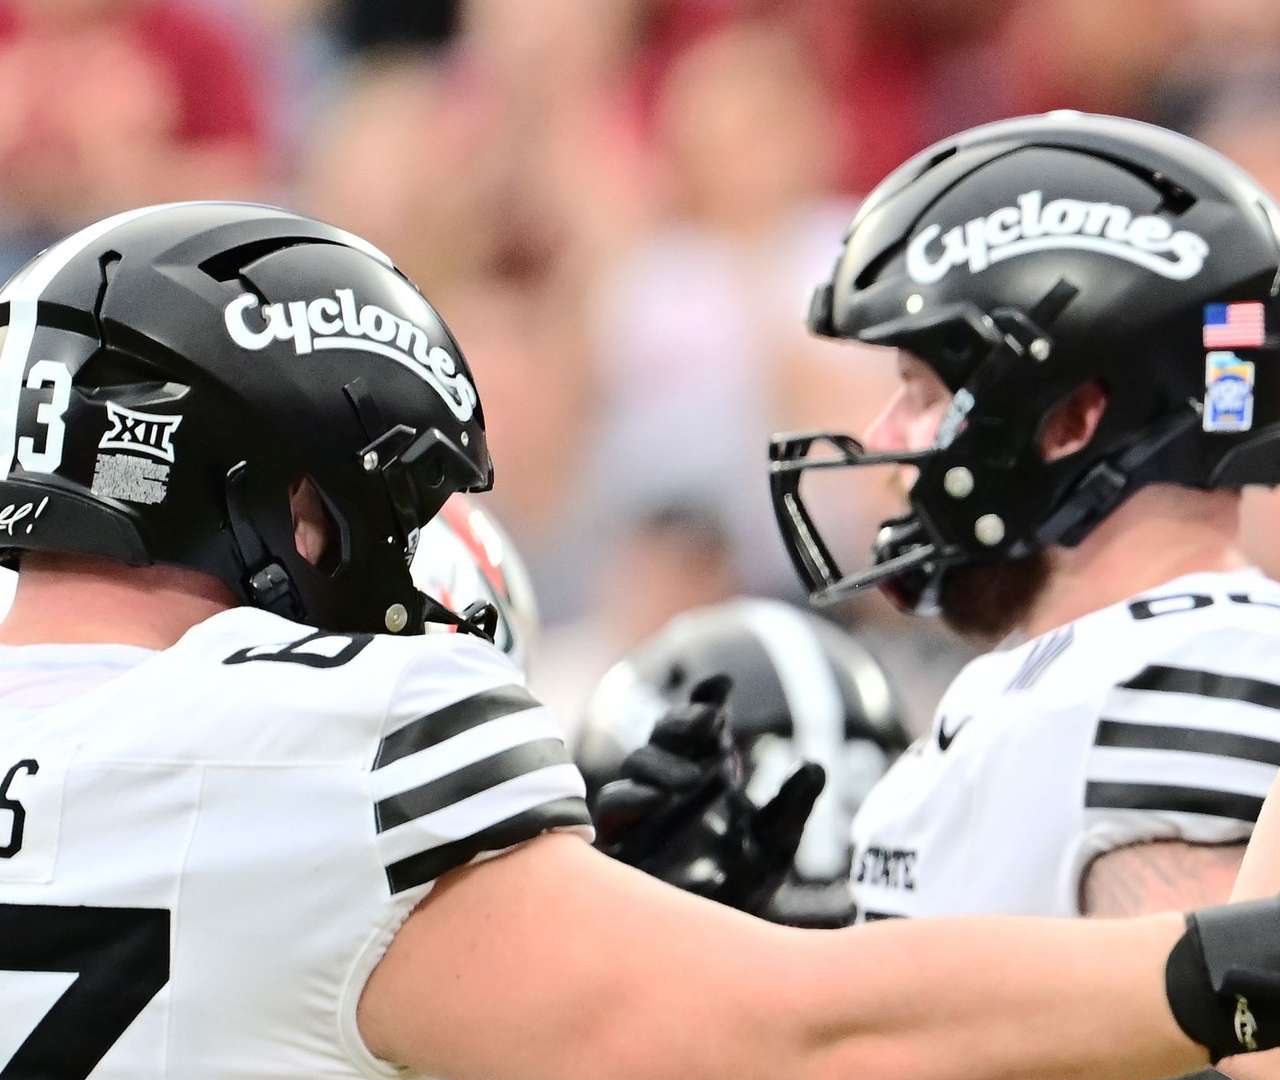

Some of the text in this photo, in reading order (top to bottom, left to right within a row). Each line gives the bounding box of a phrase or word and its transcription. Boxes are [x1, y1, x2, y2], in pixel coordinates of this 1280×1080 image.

[907, 190, 1209, 284] Cyclones
[224, 288, 477, 422] Cyclones
[17, 359, 73, 474] 3
[103, 405, 179, 457] XII
